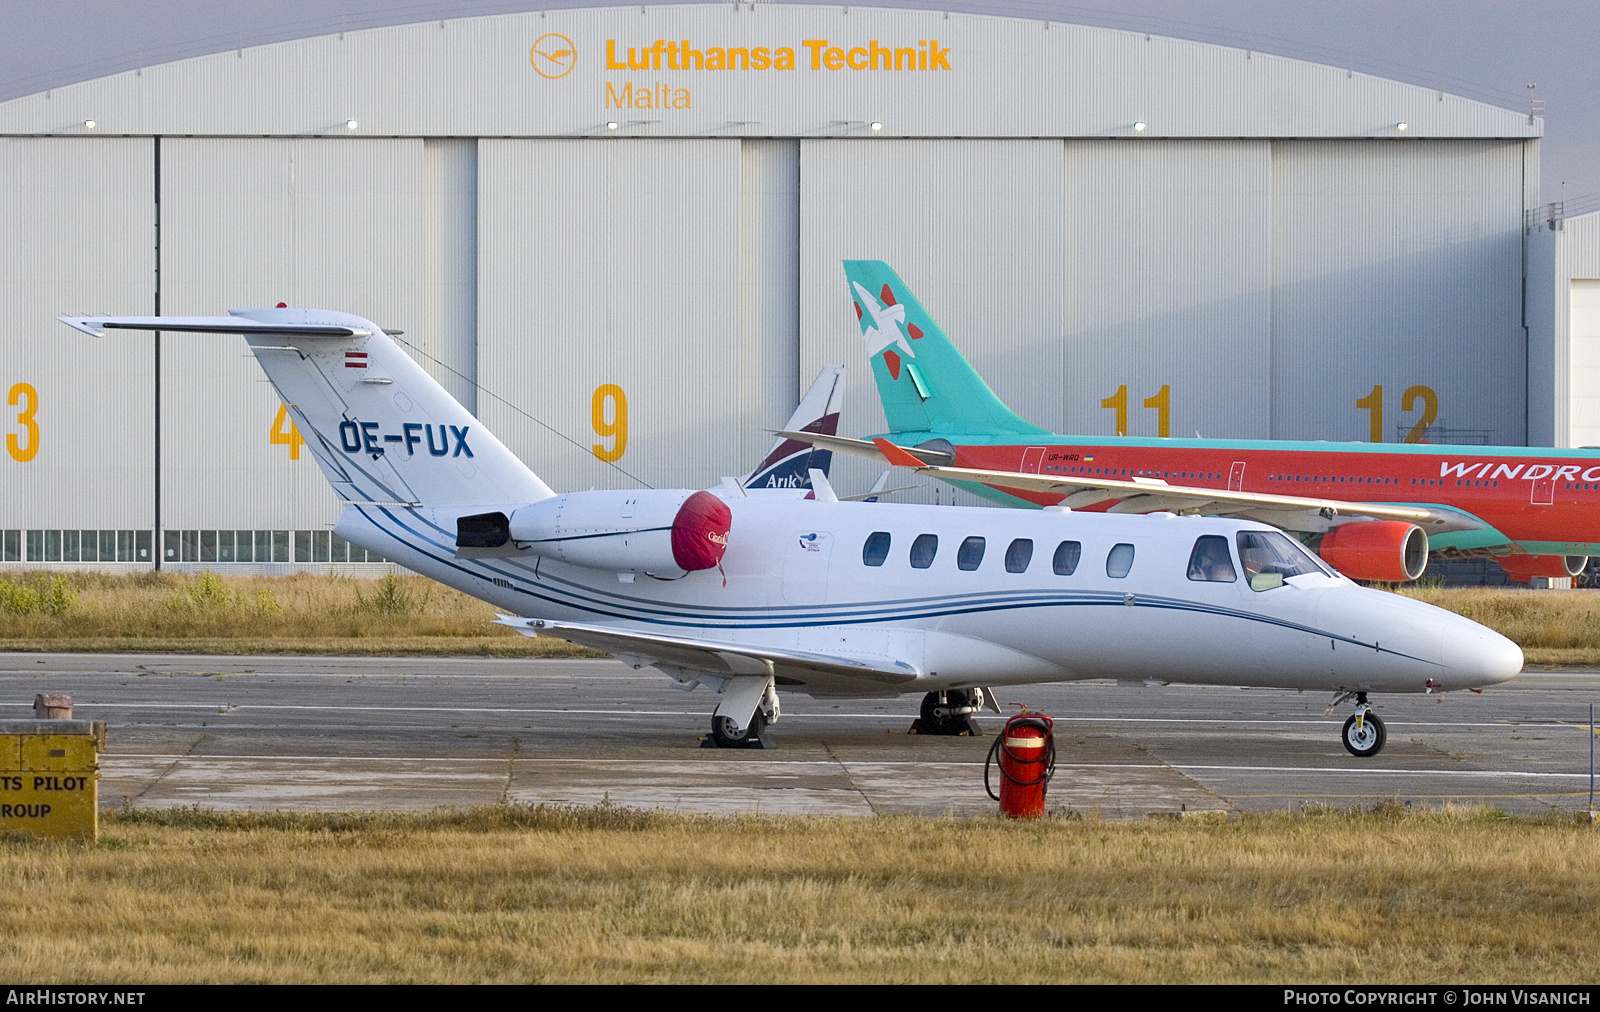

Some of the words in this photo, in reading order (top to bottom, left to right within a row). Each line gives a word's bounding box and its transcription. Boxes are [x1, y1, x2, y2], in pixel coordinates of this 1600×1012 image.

[606, 39, 796, 71] Lufthansa
[802, 39, 953, 71] Technik
[606, 80, 692, 110] Malta
[6, 383, 40, 463] 3
[270, 402, 305, 460] 4
[591, 384, 628, 462] 9
[1101, 384, 1170, 438] 11
[1356, 384, 1438, 445] 12
[338, 420, 475, 459] OE-FUX
[0, 776, 23, 791] TS
[33, 776, 88, 791] PILOT
